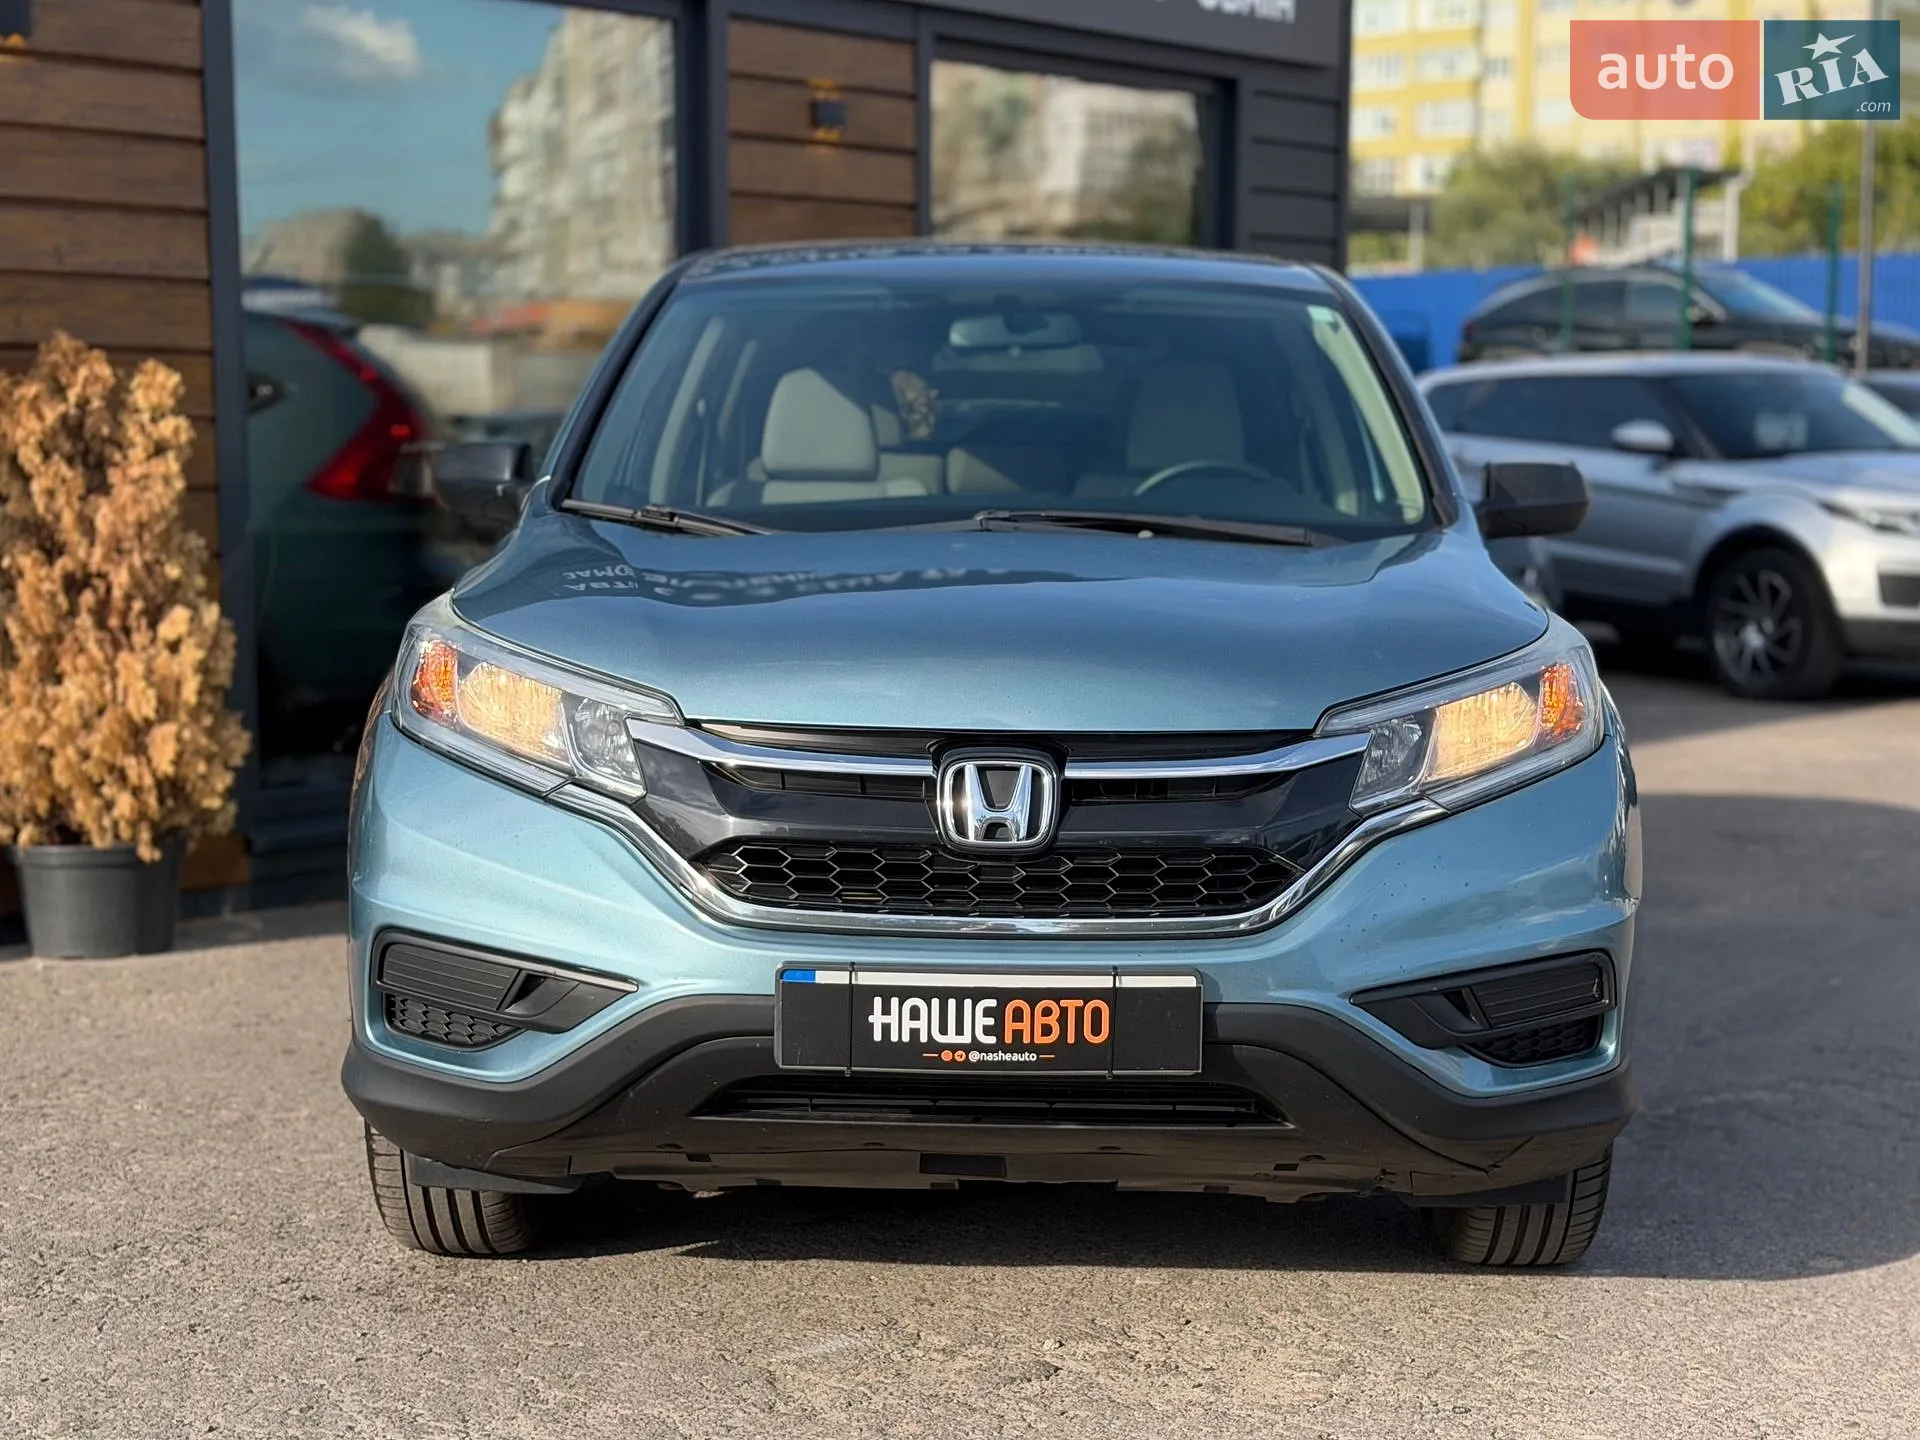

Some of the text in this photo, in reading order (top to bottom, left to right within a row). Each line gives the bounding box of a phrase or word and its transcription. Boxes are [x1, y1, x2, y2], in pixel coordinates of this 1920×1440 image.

[868, 996, 1110, 1044] НАШЕ АВТО
[968, 1050, 1037, 1062] @nasheauto
